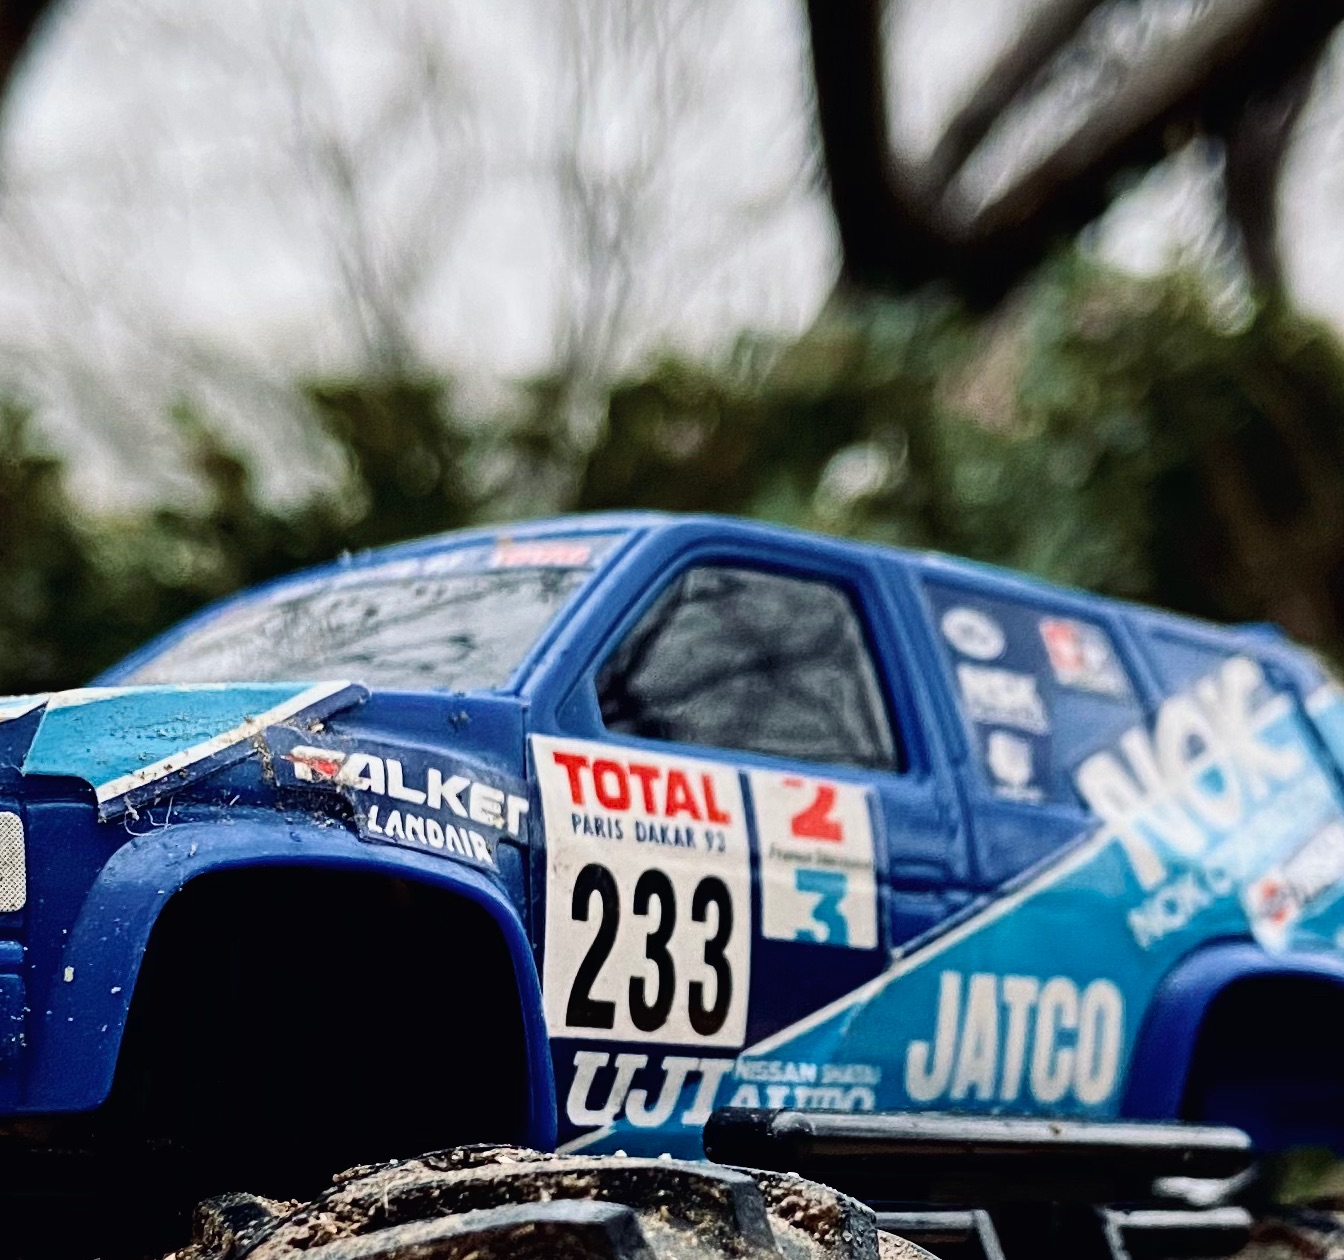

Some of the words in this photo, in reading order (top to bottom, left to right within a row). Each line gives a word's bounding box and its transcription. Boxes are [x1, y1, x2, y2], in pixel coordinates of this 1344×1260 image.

[553, 752, 731, 825] TOTAL
[367, 804, 496, 865] LANDAIR
[571, 812, 624, 840] PARIS
[635, 820, 696, 849] DAKAR
[794, 868, 850, 947] 3
[565, 863, 734, 1037] 233
[906, 971, 1123, 1105] JATCO
